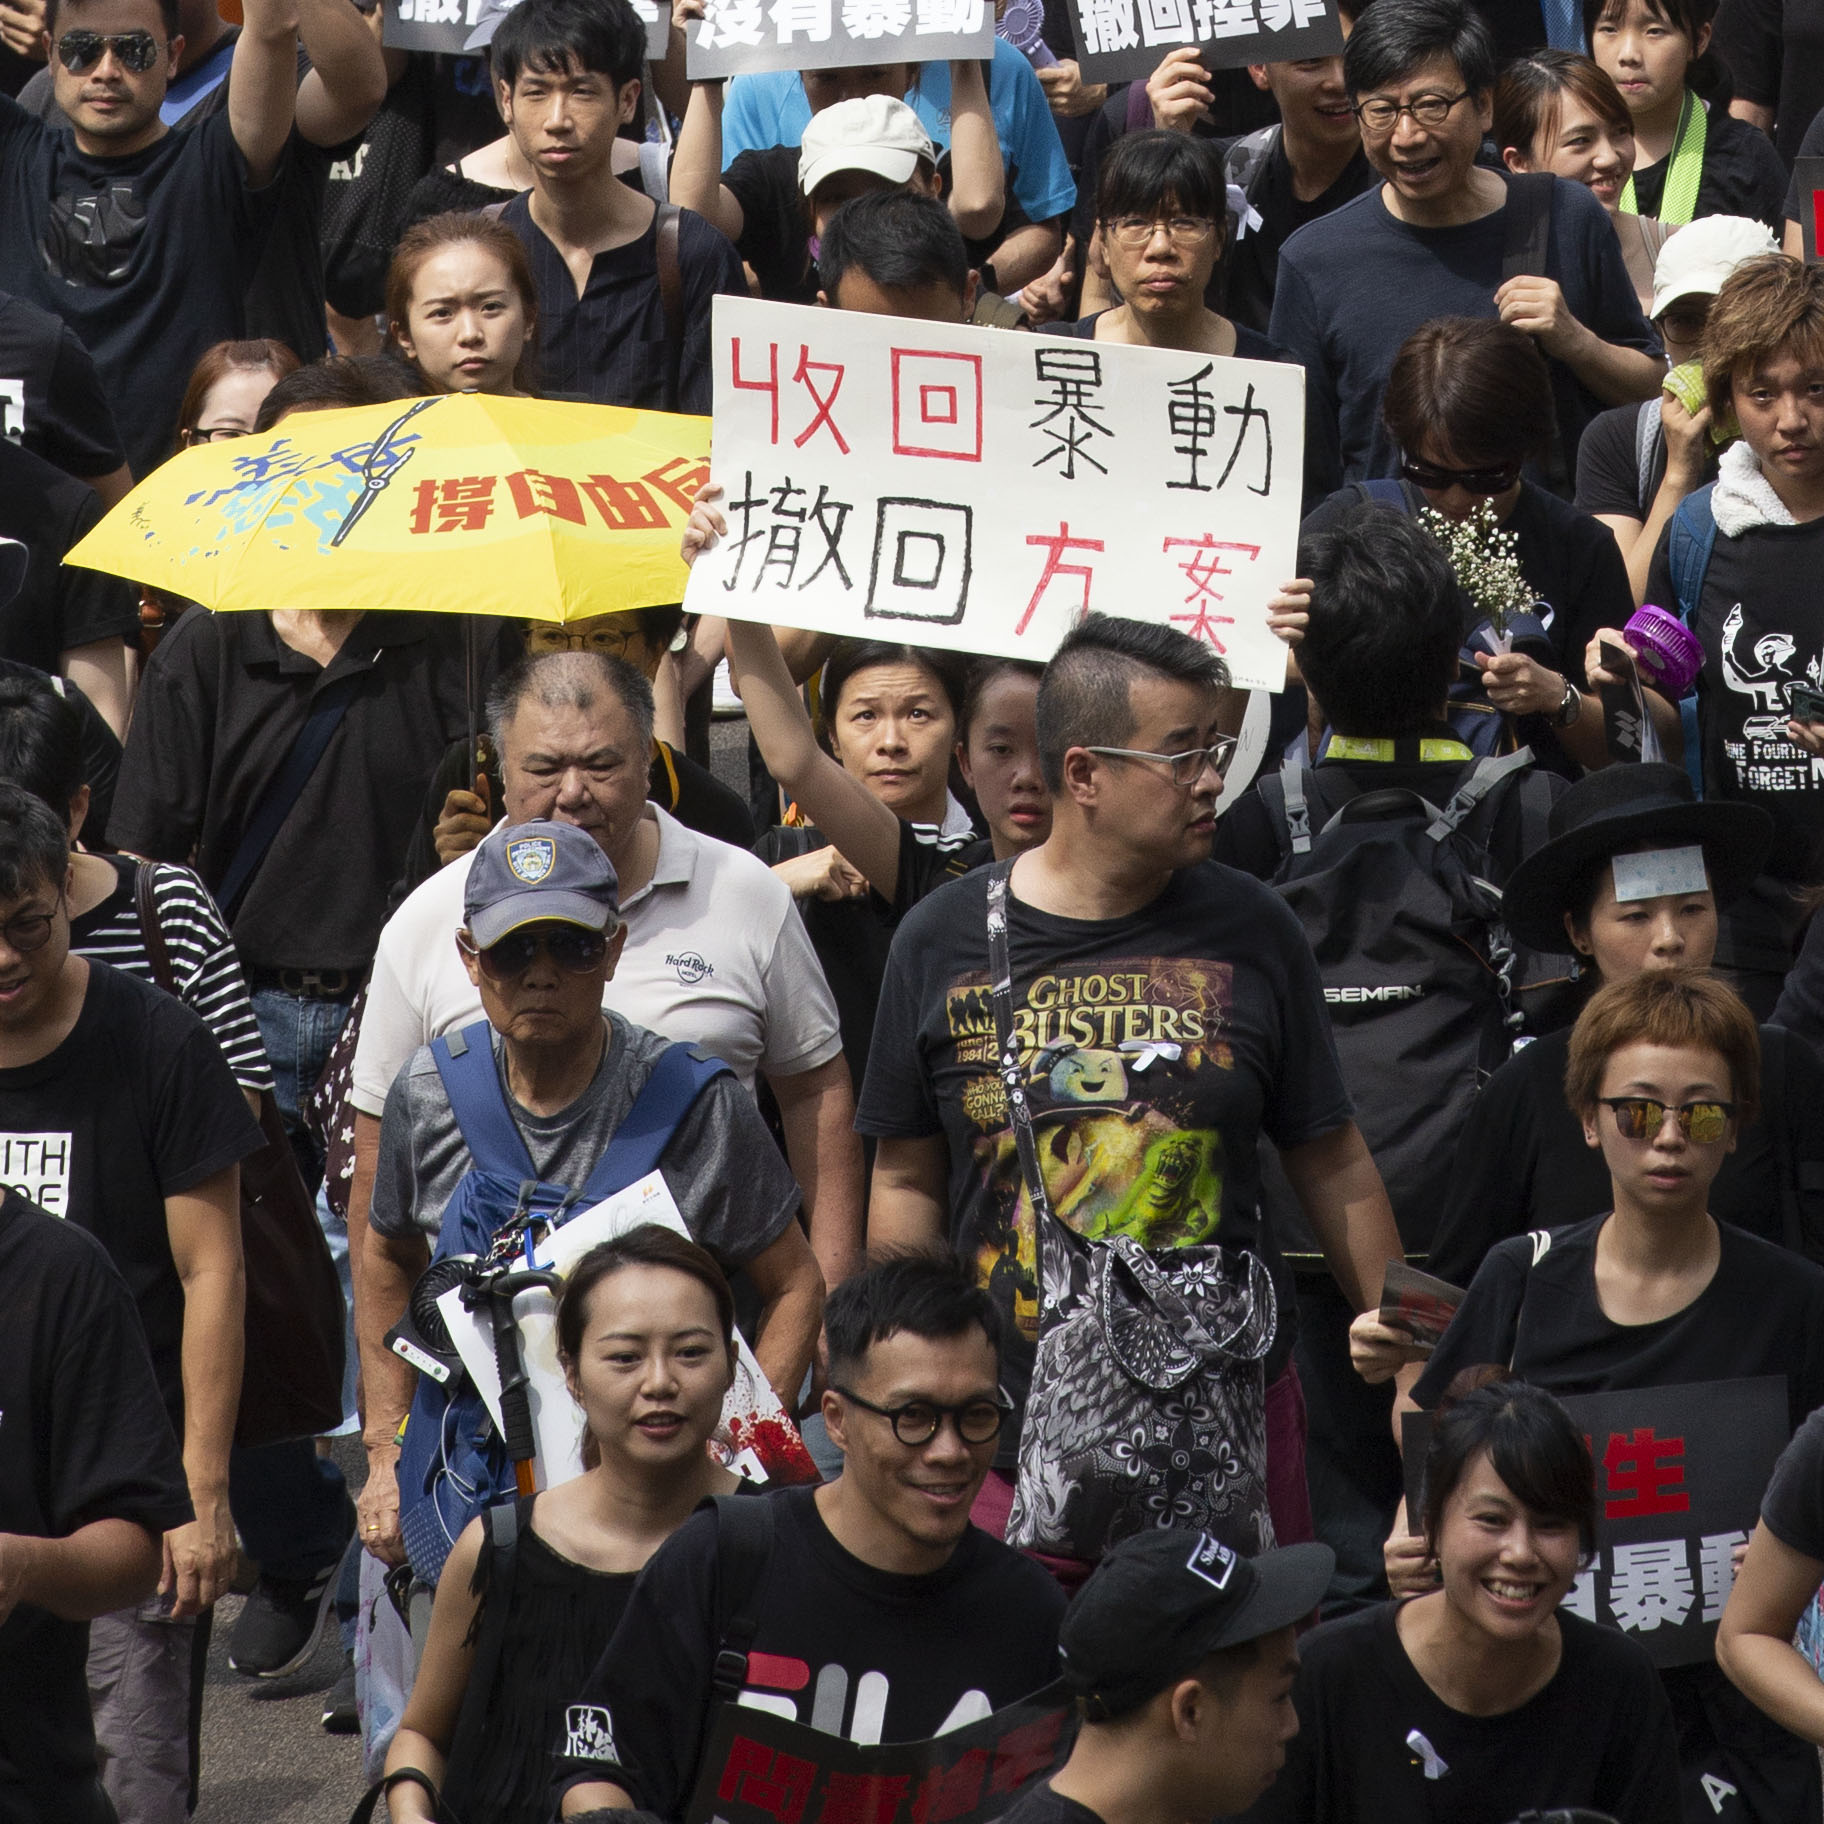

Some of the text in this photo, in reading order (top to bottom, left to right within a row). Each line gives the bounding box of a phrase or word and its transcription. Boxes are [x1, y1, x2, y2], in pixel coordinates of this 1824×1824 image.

[730, 336, 1272, 498] 收回暴動
[721, 469, 1262, 656] 撤回方案
[1735, 760, 1809, 792] FORGET
[665, 954, 715, 979] Hard Rock
[1027, 973, 1152, 1010] GHOST
[1322, 984, 1419, 1003] SEMAN
[1012, 1003, 1206, 1066] BUSTERS
[965, 1092, 1009, 1110] GONNA
[970, 1106, 1005, 1122] CALL?
[2, 1138, 67, 1176] ITH
[1600, 1428, 1690, 1520] 生
